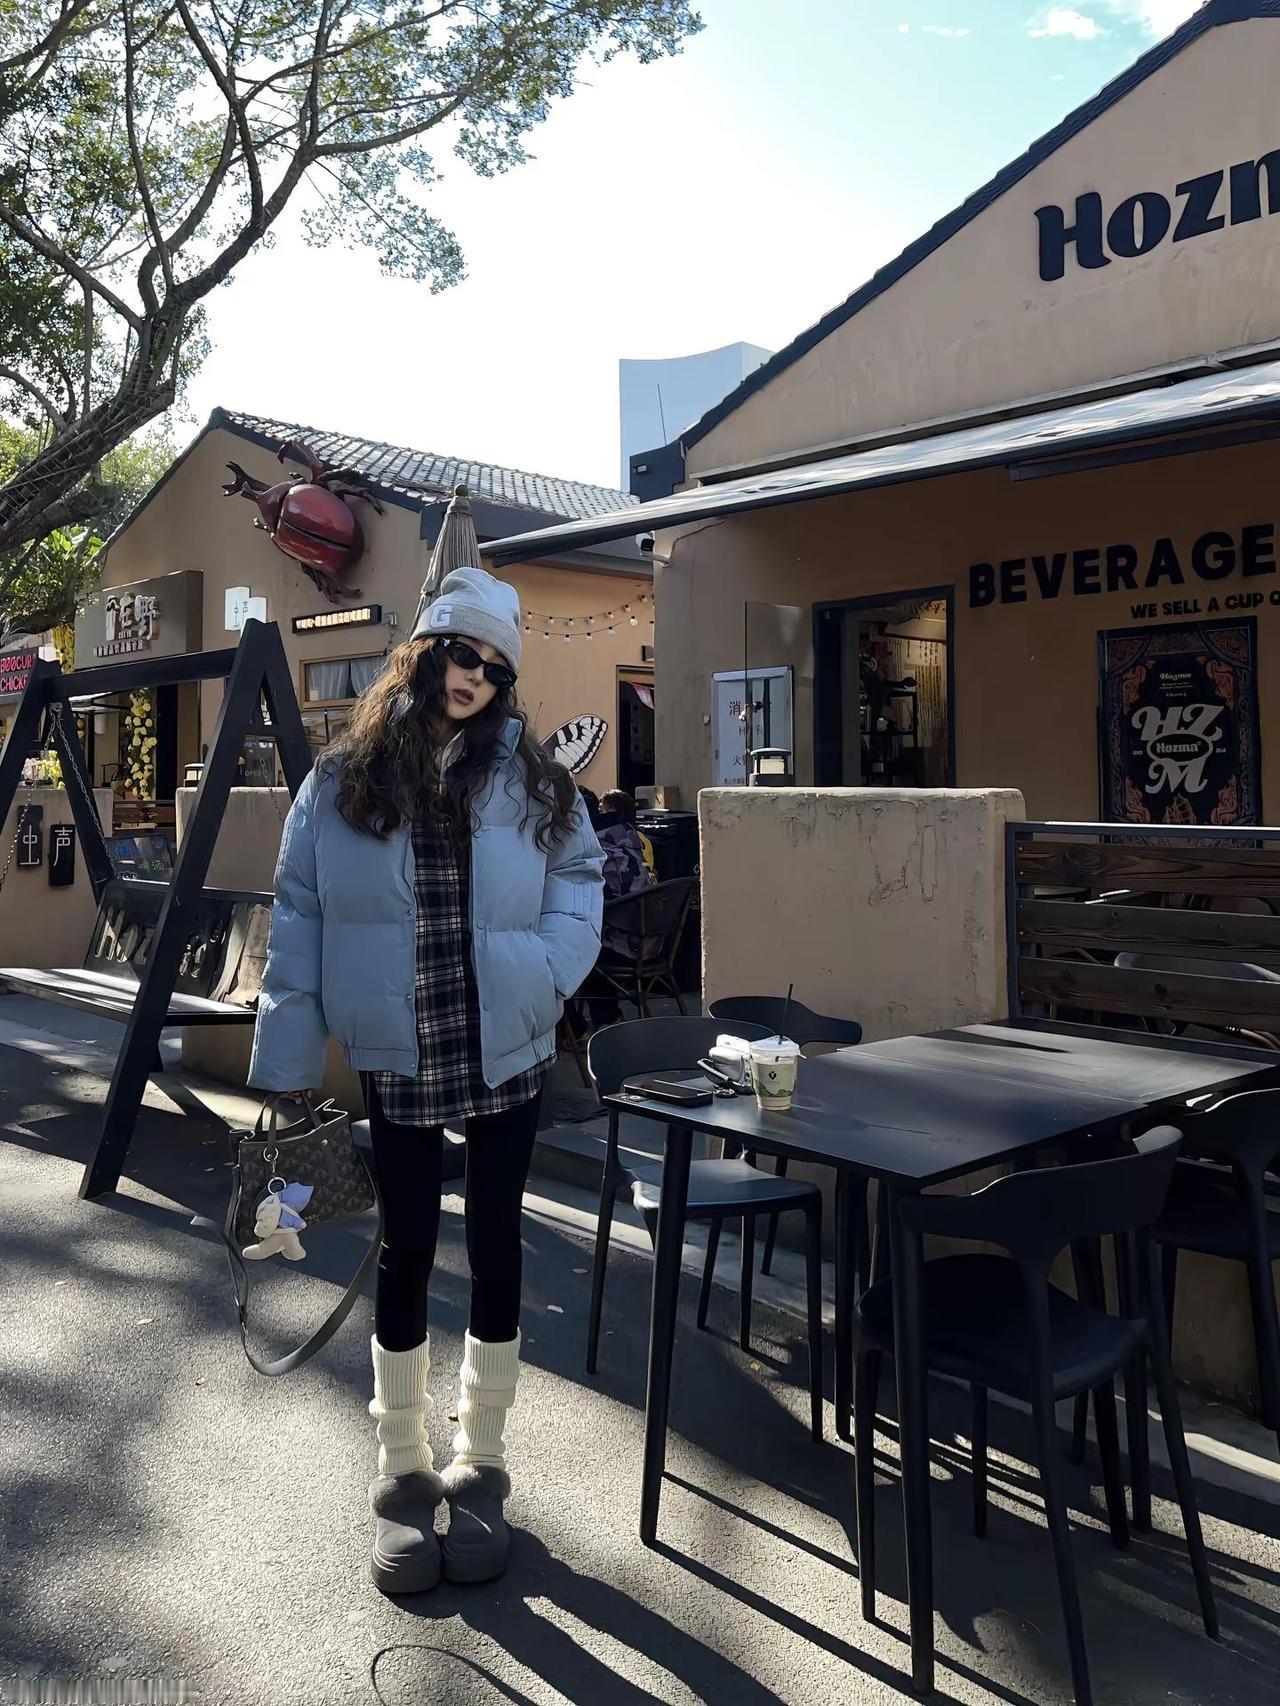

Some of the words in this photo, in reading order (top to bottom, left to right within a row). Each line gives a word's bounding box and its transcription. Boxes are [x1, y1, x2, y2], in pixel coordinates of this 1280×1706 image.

[969, 523, 1277, 608] BEVERAGE
[430, 604, 453, 628] G
[1131, 603, 1157, 619] WE
[1162, 599, 1202, 615] SELL
[1208, 597, 1220, 612] A
[1225, 592, 1264, 609] CUP
